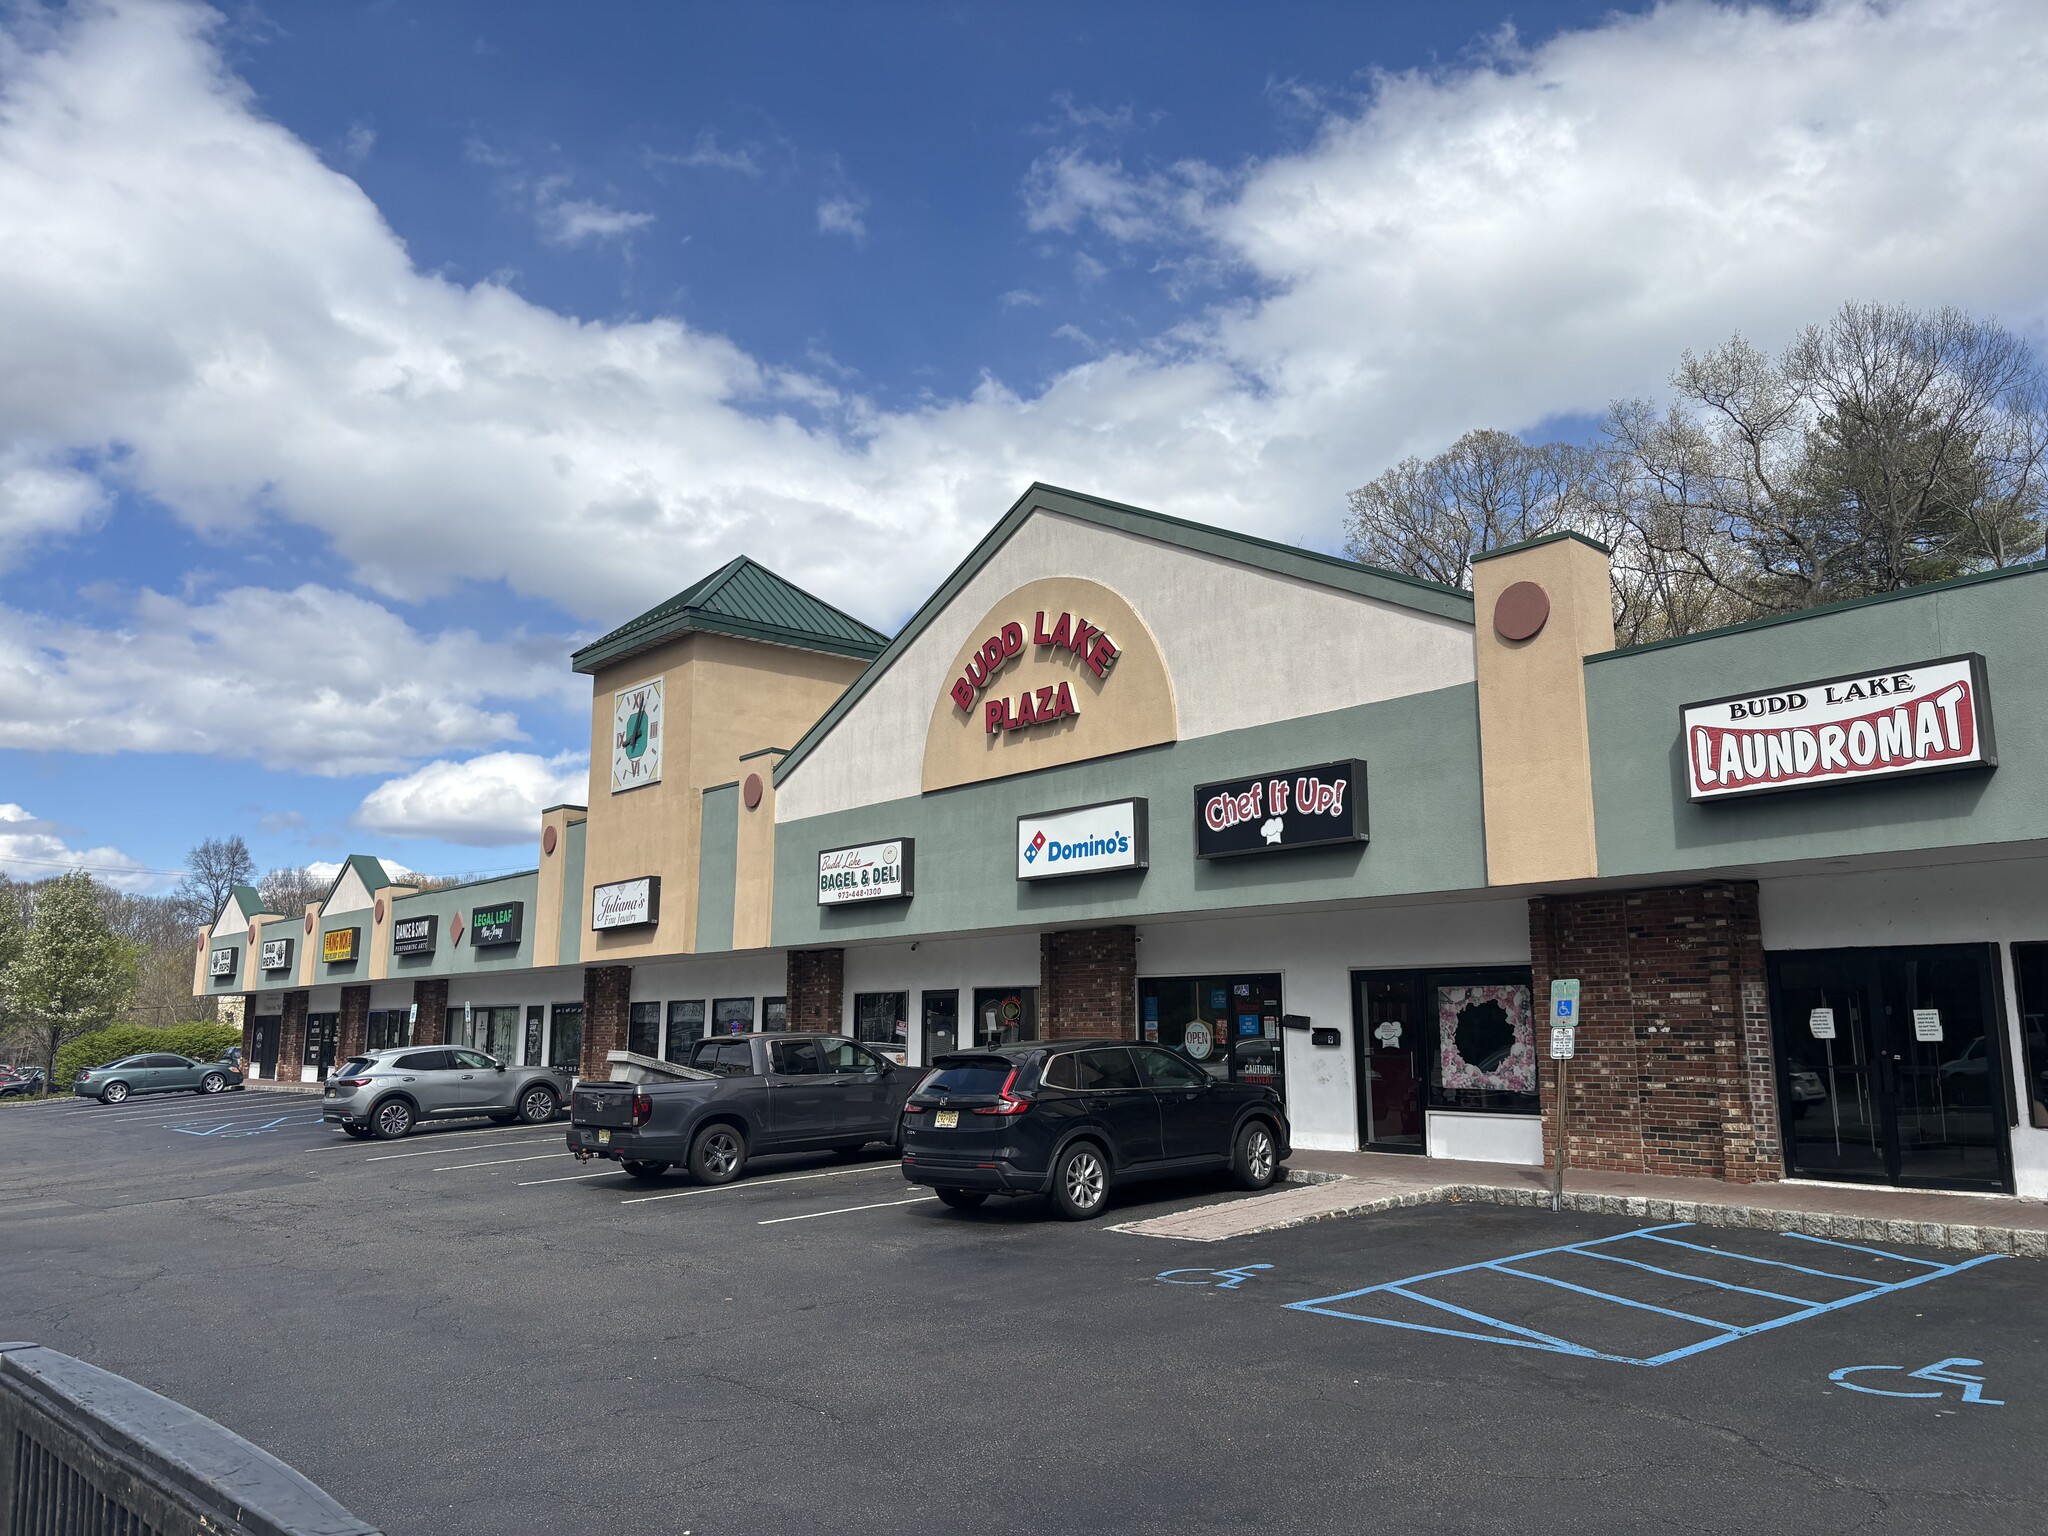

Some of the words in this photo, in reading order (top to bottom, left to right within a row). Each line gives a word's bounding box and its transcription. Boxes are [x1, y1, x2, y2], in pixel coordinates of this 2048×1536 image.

[950, 622, 1026, 712] BUDD
[1034, 611, 1120, 678] LAKE
[985, 681, 1079, 733] PLAZA
[1729, 692, 1808, 720] BUDD
[1824, 674, 1915, 705] LAKE
[1695, 682, 1965, 785] LAUNDROMAT
[1205, 782, 1262, 831] Chef
[1269, 780, 1290, 815] It
[1296, 777, 1346, 817] Up!
[1048, 830, 1130, 862] Domino's
[822, 854, 843, 871] Budd
[842, 851, 865, 869] Lake
[821, 871, 858, 892] BAGEL
[861, 869, 870, 887] &
[873, 864, 900, 885] DELI
[597, 893, 645, 921] Juliana's
[474, 912, 495, 927] LEGAL
[495, 909, 512, 924] LEAF
[604, 914, 616, 925] Fine
[616, 911, 635, 926] Jewelry
[221, 951, 229, 960] BAD
[265, 943, 275, 954] BAD
[219, 963, 230, 972] REPS
[263, 956, 275, 967] REPS
[1186, 1031, 1208, 1045] OPEN
[1244, 1064, 1273, 1075] CAUTION!
